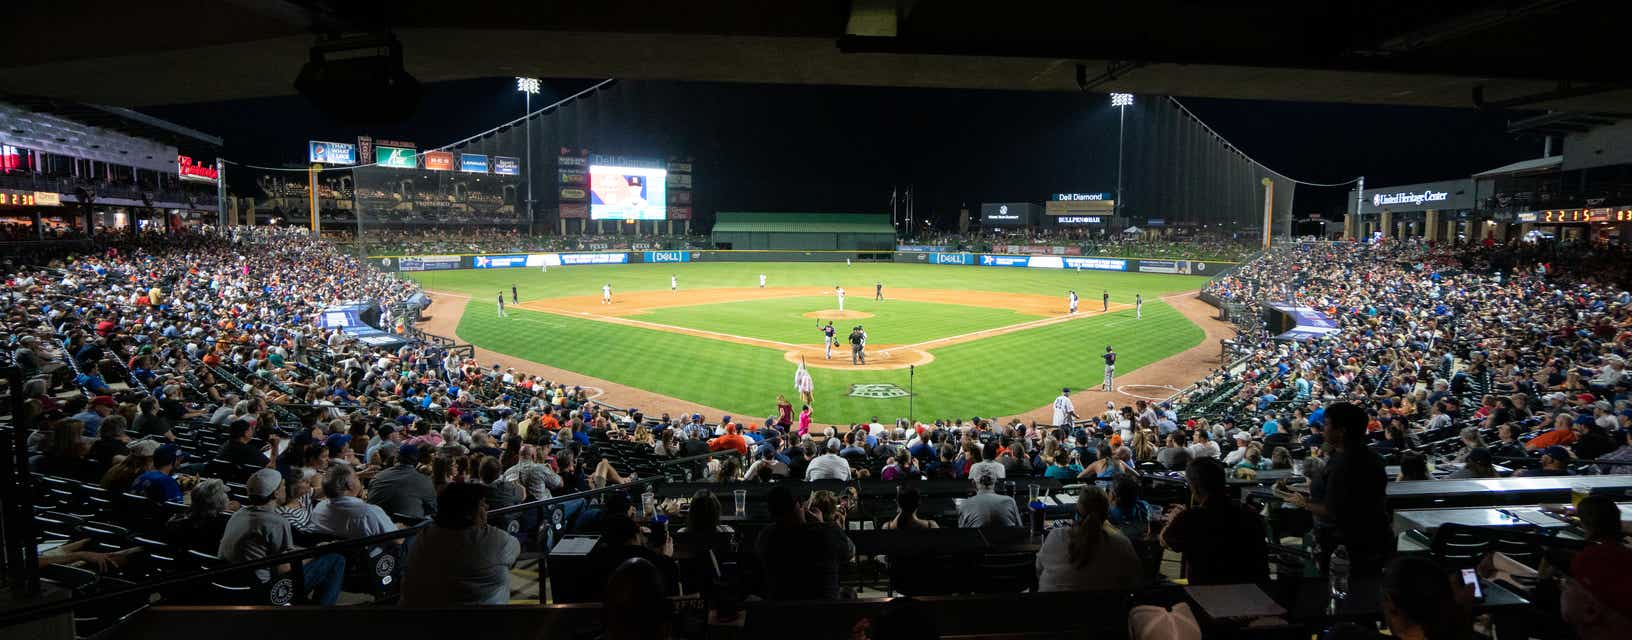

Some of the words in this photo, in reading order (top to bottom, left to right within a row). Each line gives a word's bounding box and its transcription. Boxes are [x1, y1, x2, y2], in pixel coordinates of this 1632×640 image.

[1381, 193, 1400, 204] United
[1400, 192, 1424, 205] Heritage
[1424, 190, 1448, 201] Center
[1545, 210, 1552, 222] 2
[1558, 210, 1565, 222] 2
